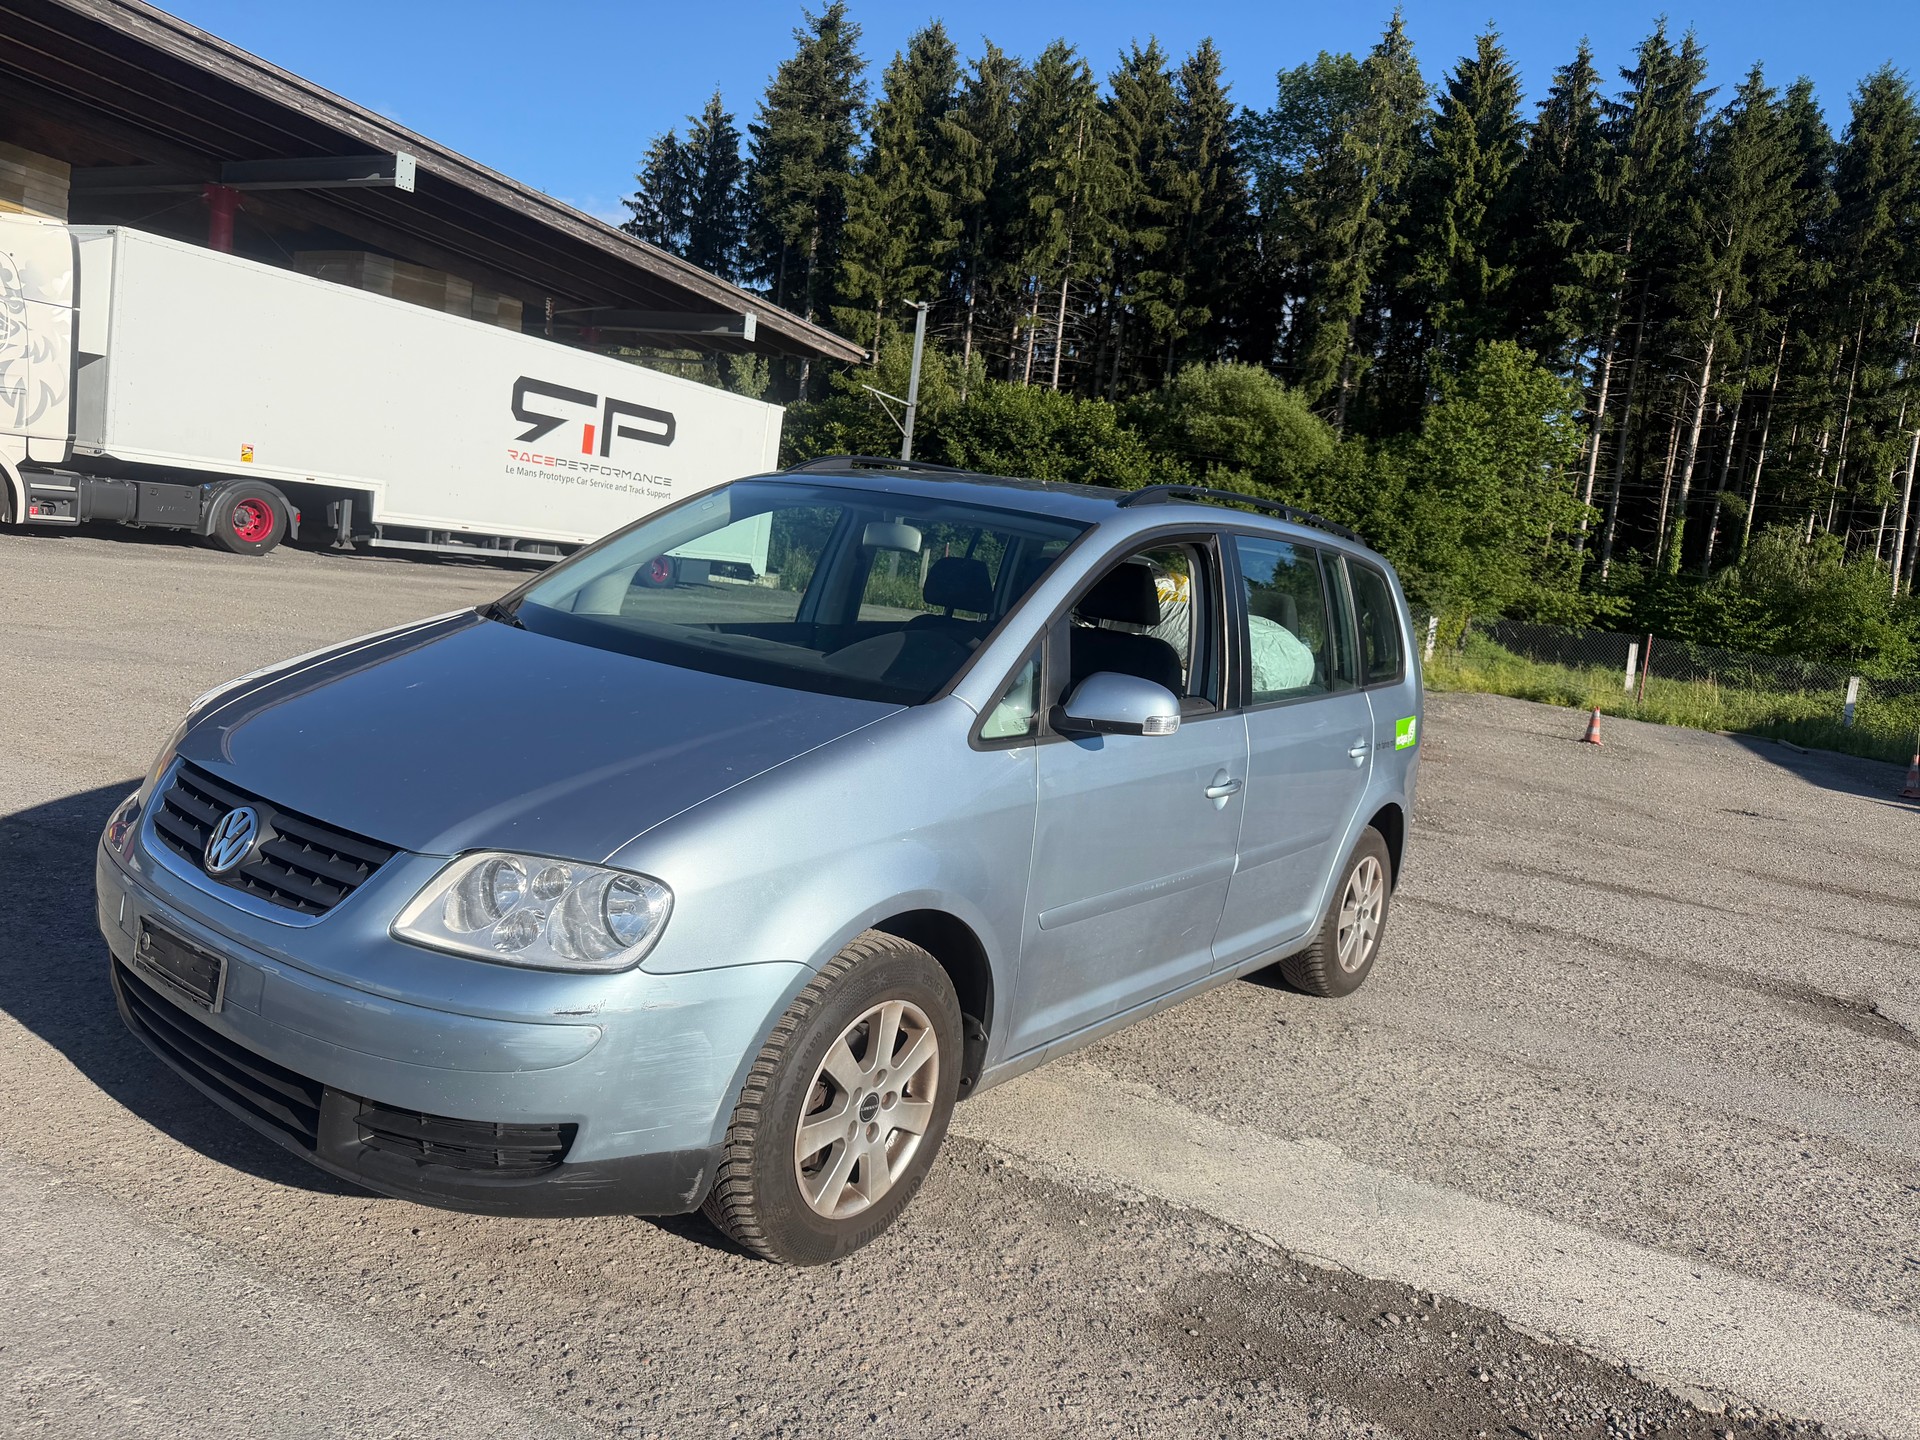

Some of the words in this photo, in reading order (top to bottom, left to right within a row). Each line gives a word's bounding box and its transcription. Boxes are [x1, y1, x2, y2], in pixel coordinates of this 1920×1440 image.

[505, 464, 515, 475] Le
[516, 466, 537, 479] Mans
[539, 470, 575, 485] Prototype
[576, 476, 588, 486] Car
[589, 478, 614, 491] Service
[614, 482, 628, 493] and
[629, 484, 645, 496] Track
[646, 488, 671, 501] Support
[507, 449, 672, 487] RACEPERFORMANCE
[205, 806, 259, 874] VW
